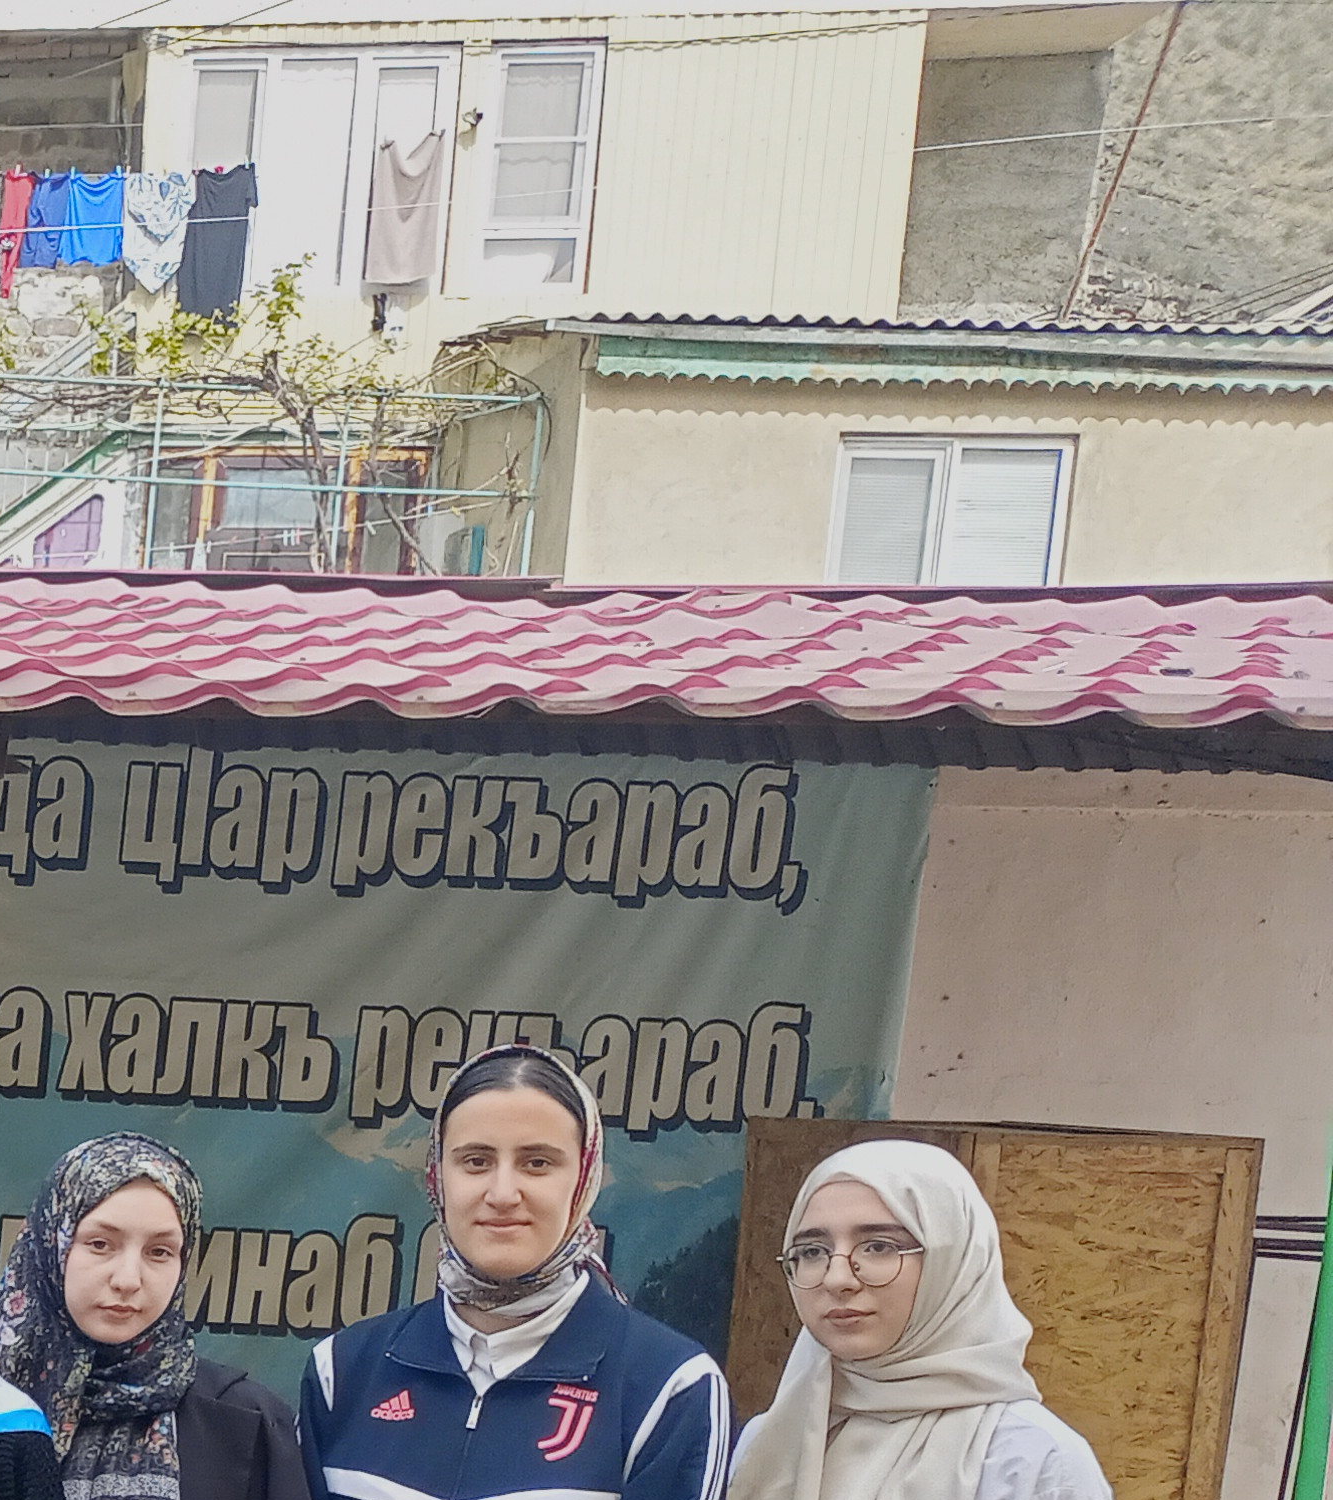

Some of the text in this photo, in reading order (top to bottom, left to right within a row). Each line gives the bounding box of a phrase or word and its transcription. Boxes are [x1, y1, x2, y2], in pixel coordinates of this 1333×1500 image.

[331, 763, 809, 916] рекъараб,
[57, 989, 341, 1117] халкъ
[369, 1406, 416, 1422] adidas
[552, 1383, 601, 1403] JUVENTUS
